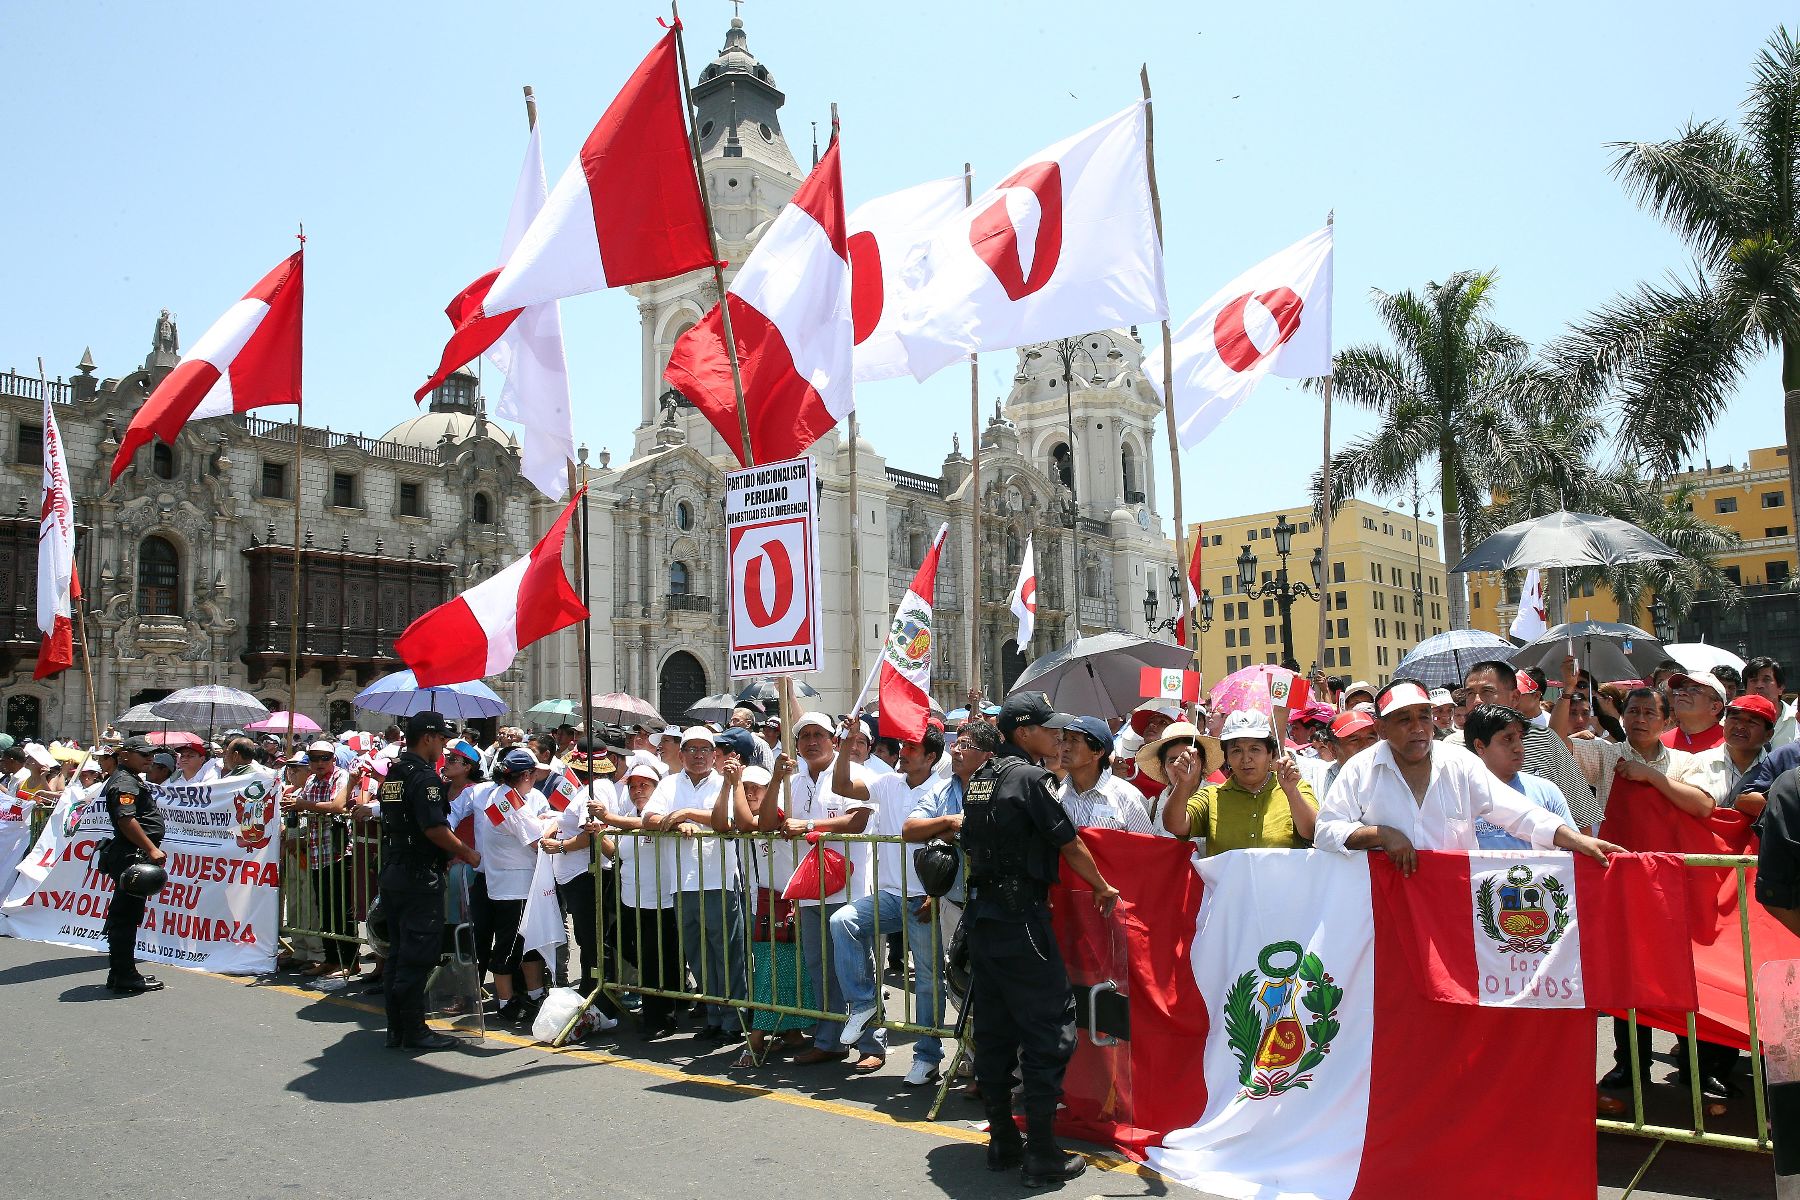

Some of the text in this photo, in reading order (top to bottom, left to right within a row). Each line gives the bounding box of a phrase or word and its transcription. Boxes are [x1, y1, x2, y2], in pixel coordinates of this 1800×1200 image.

[727, 464, 807, 492] PARTIDO NACIONALISTA
[744, 486, 788, 507] PERUANO
[727, 502, 808, 524] HONESTIDAD ES LA DIFERENCIA
[732, 648, 812, 671] VENTANILLA
[168, 809, 195, 824] PUEBLOS
[195, 811, 209, 826] DEL
[210, 809, 232, 826] PERÚ
[169, 852, 280, 888] NUESTRA
[148, 880, 202, 910] ERÚ
[161, 910, 257, 944] HUMALA
[73, 926, 88, 938] VOZ
[137, 941, 146, 951] ES
[147, 943, 157, 954] LA
[158, 945, 174, 958] VOZ
[174, 949, 186, 960] DE
[1485, 974, 1573, 1000] OLIVOS
